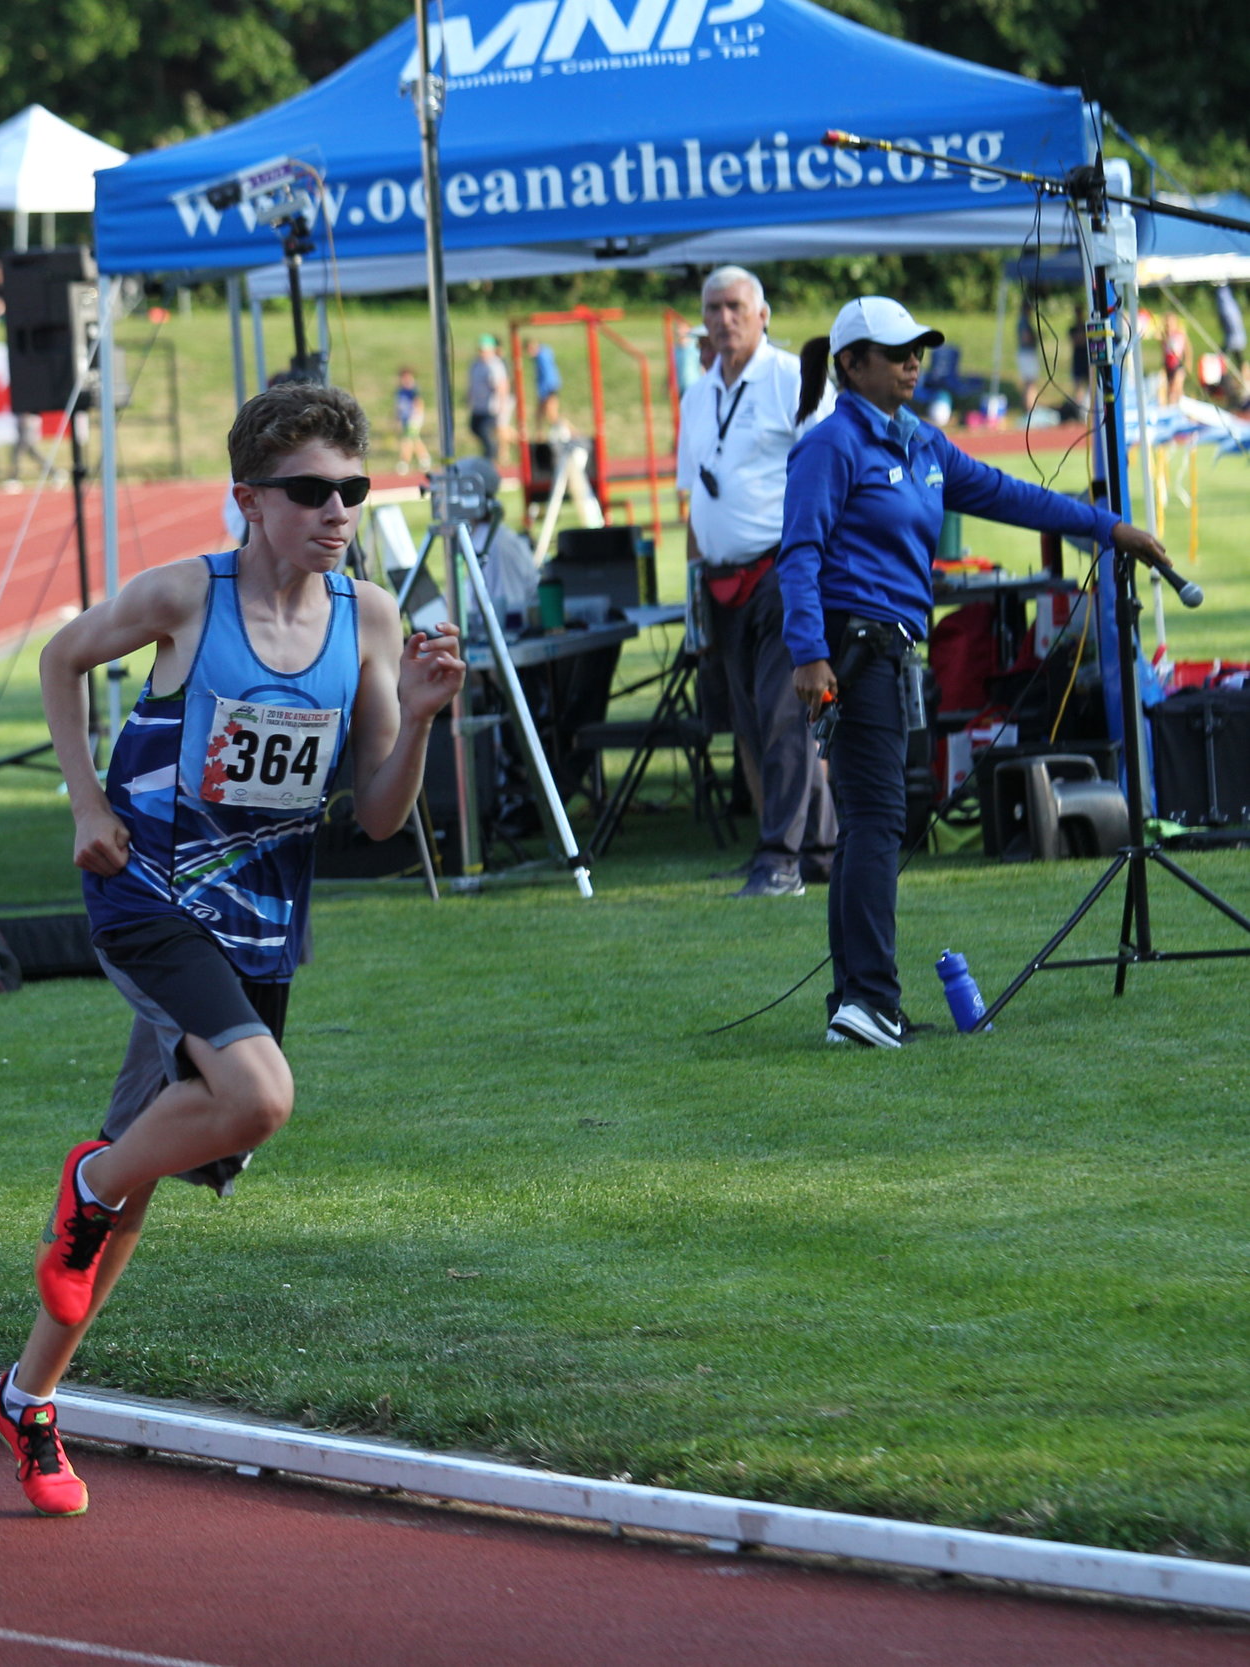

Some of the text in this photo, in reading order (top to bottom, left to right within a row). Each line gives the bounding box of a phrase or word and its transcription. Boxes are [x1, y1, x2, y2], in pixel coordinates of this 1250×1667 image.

[714, 23, 765, 46] LLP
[560, 50, 690, 75] Consulting
[267, 710, 283, 718] 2019
[293, 712, 324, 721] ATHLETICS
[226, 730, 320, 786] 364
